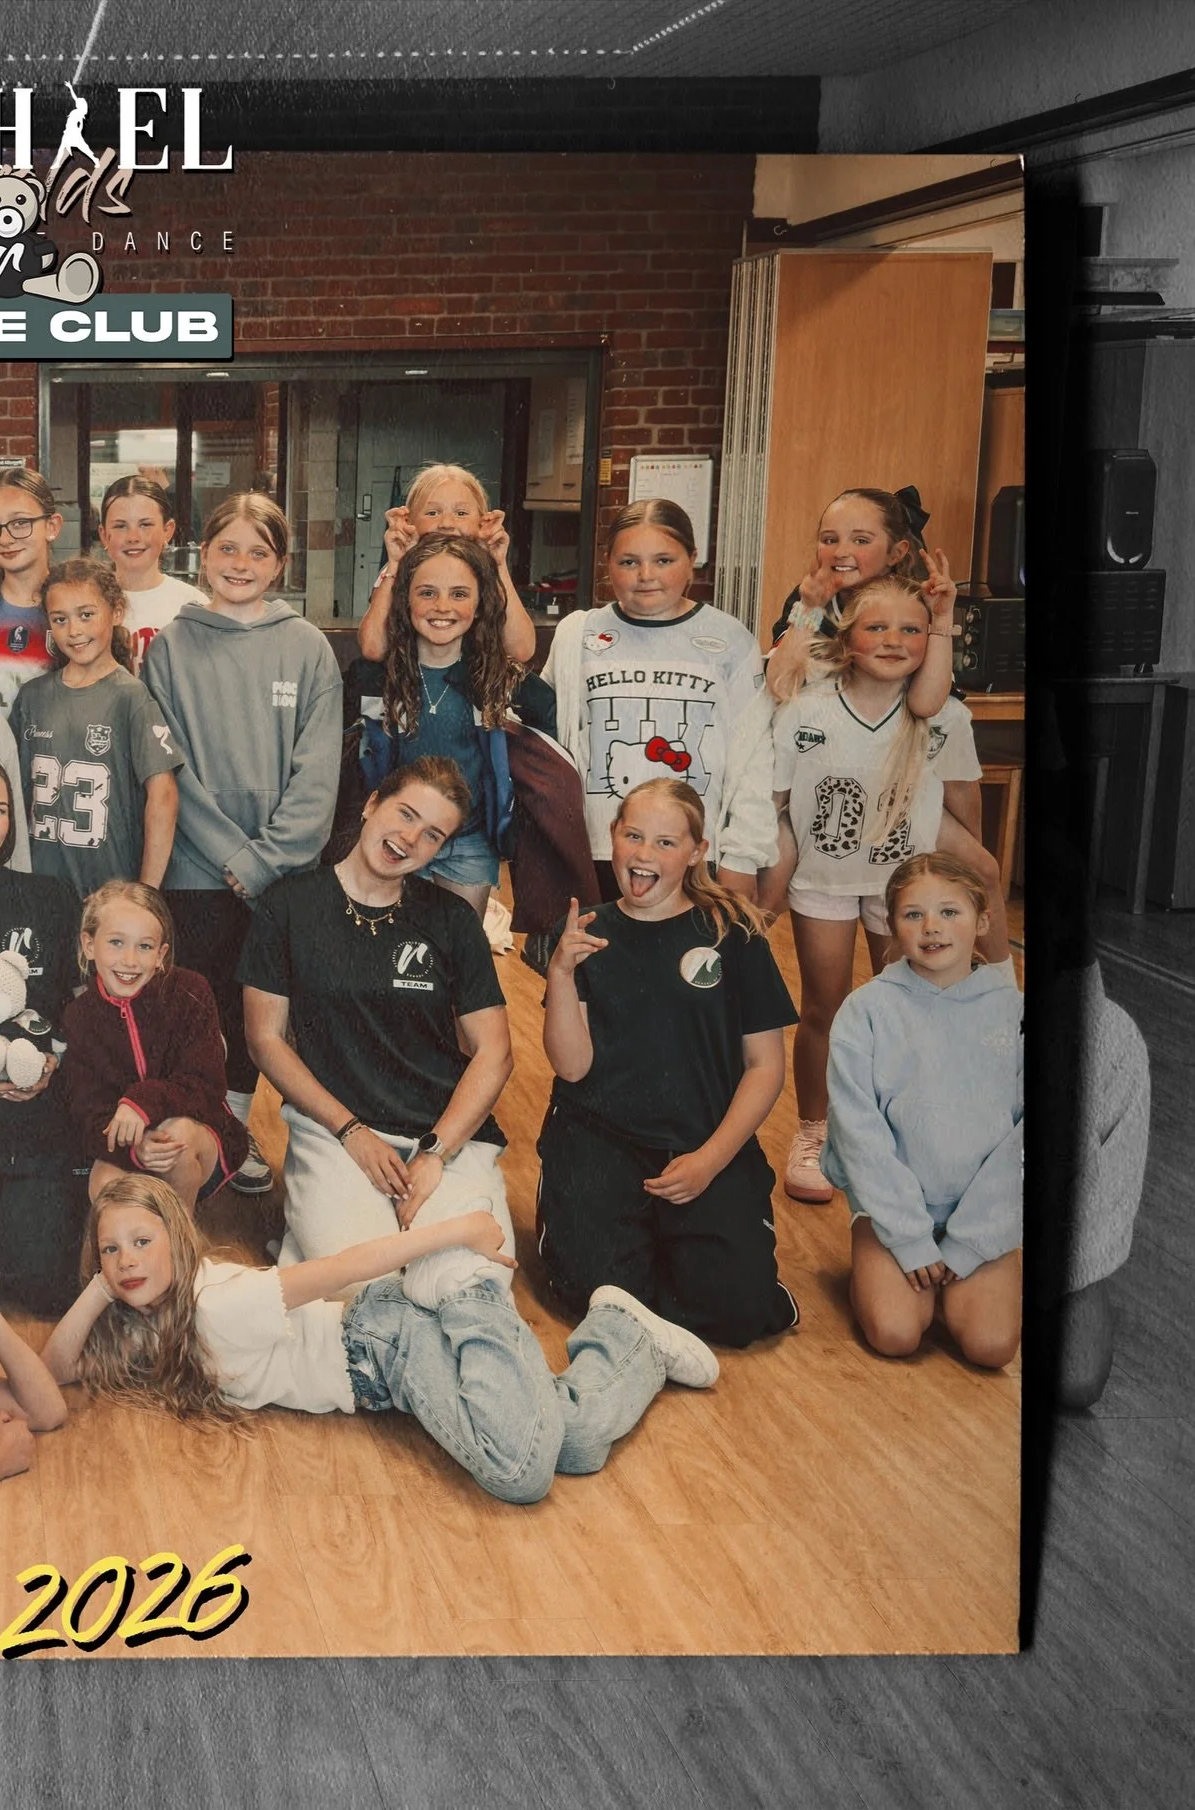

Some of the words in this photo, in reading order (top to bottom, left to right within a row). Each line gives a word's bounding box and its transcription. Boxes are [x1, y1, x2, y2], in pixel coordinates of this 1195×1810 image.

[586, 670, 646, 692] HELLO
[653, 671, 715, 693] KITTY
[29, 753, 111, 849] 23
[400, 981, 428, 989] TEAM
